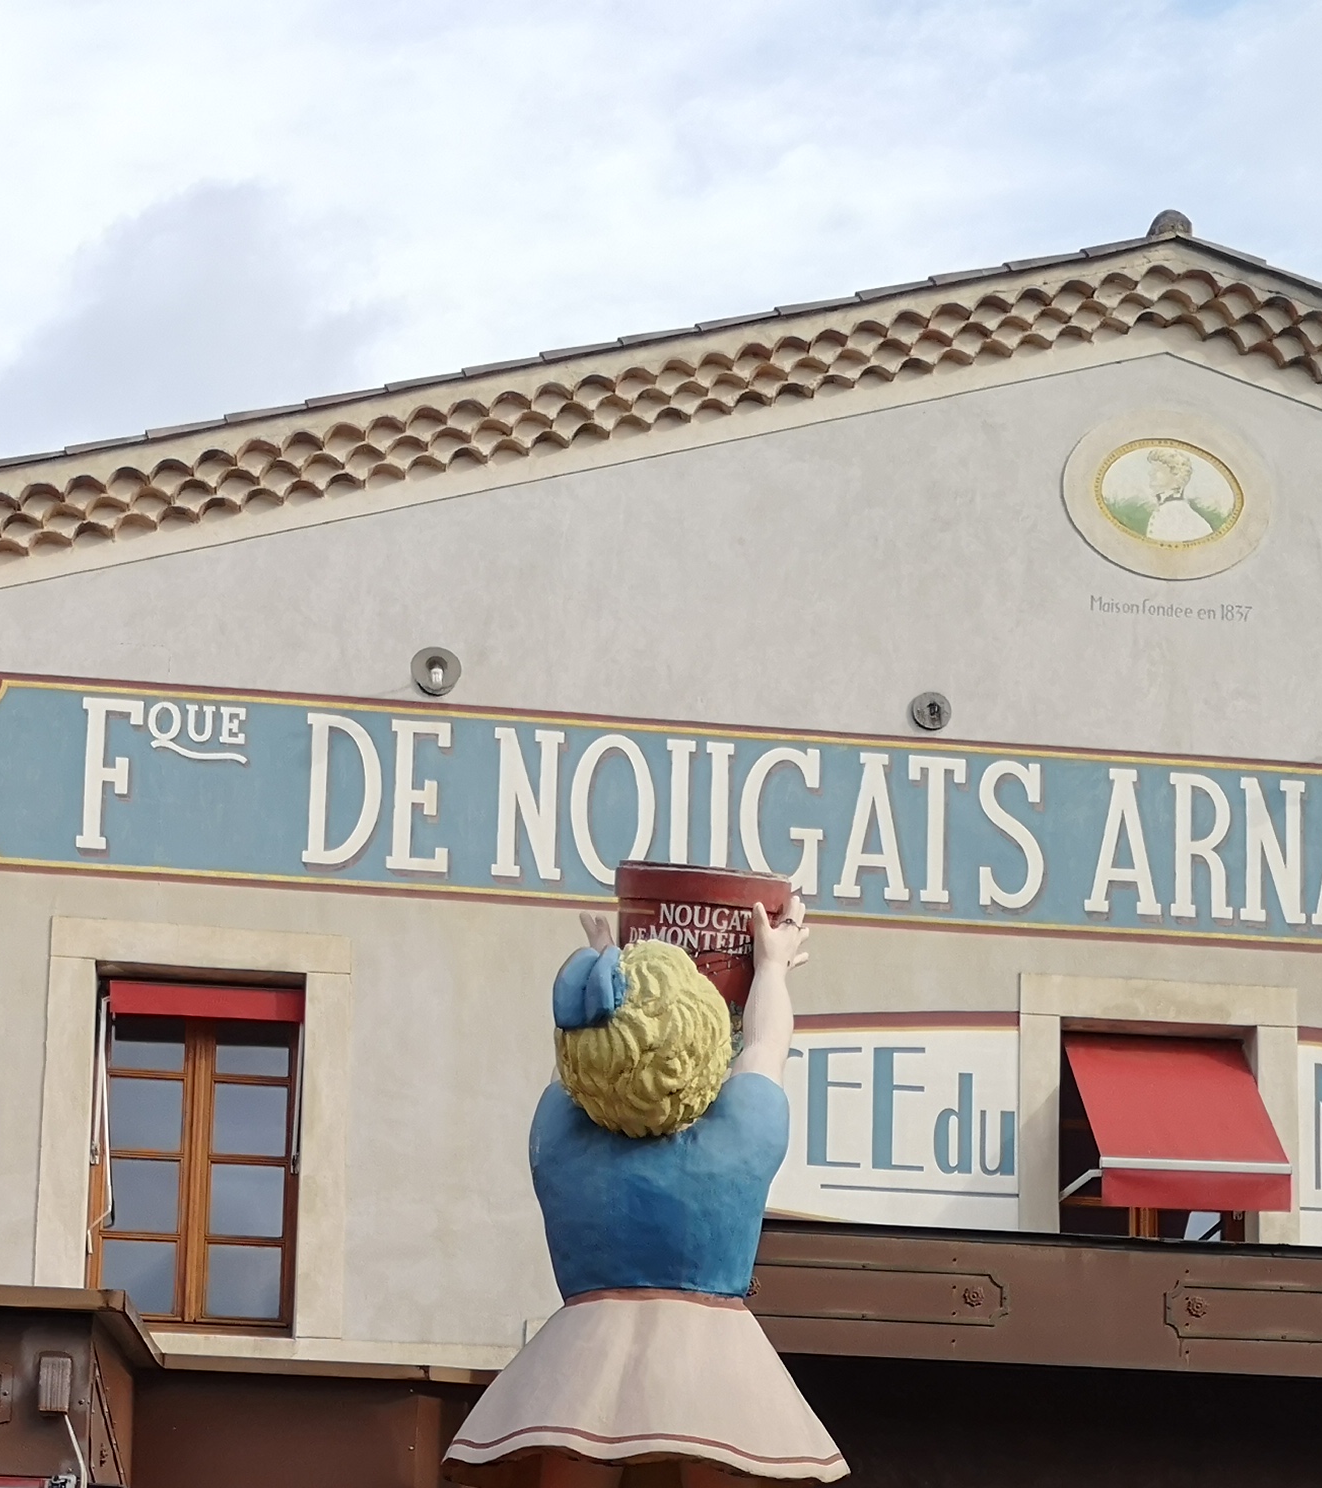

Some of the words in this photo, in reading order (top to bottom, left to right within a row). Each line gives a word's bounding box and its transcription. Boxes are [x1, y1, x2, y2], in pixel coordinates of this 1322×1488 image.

[1197, 606, 1216, 621] en
[1221, 603, 1253, 623] 1837
[301, 710, 453, 875] DE
[490, 723, 1045, 910] NOUGATS
[659, 902, 753, 932] NOUGAT
[788, 1045, 926, 1173] EE
[933, 1071, 1016, 1177] du
